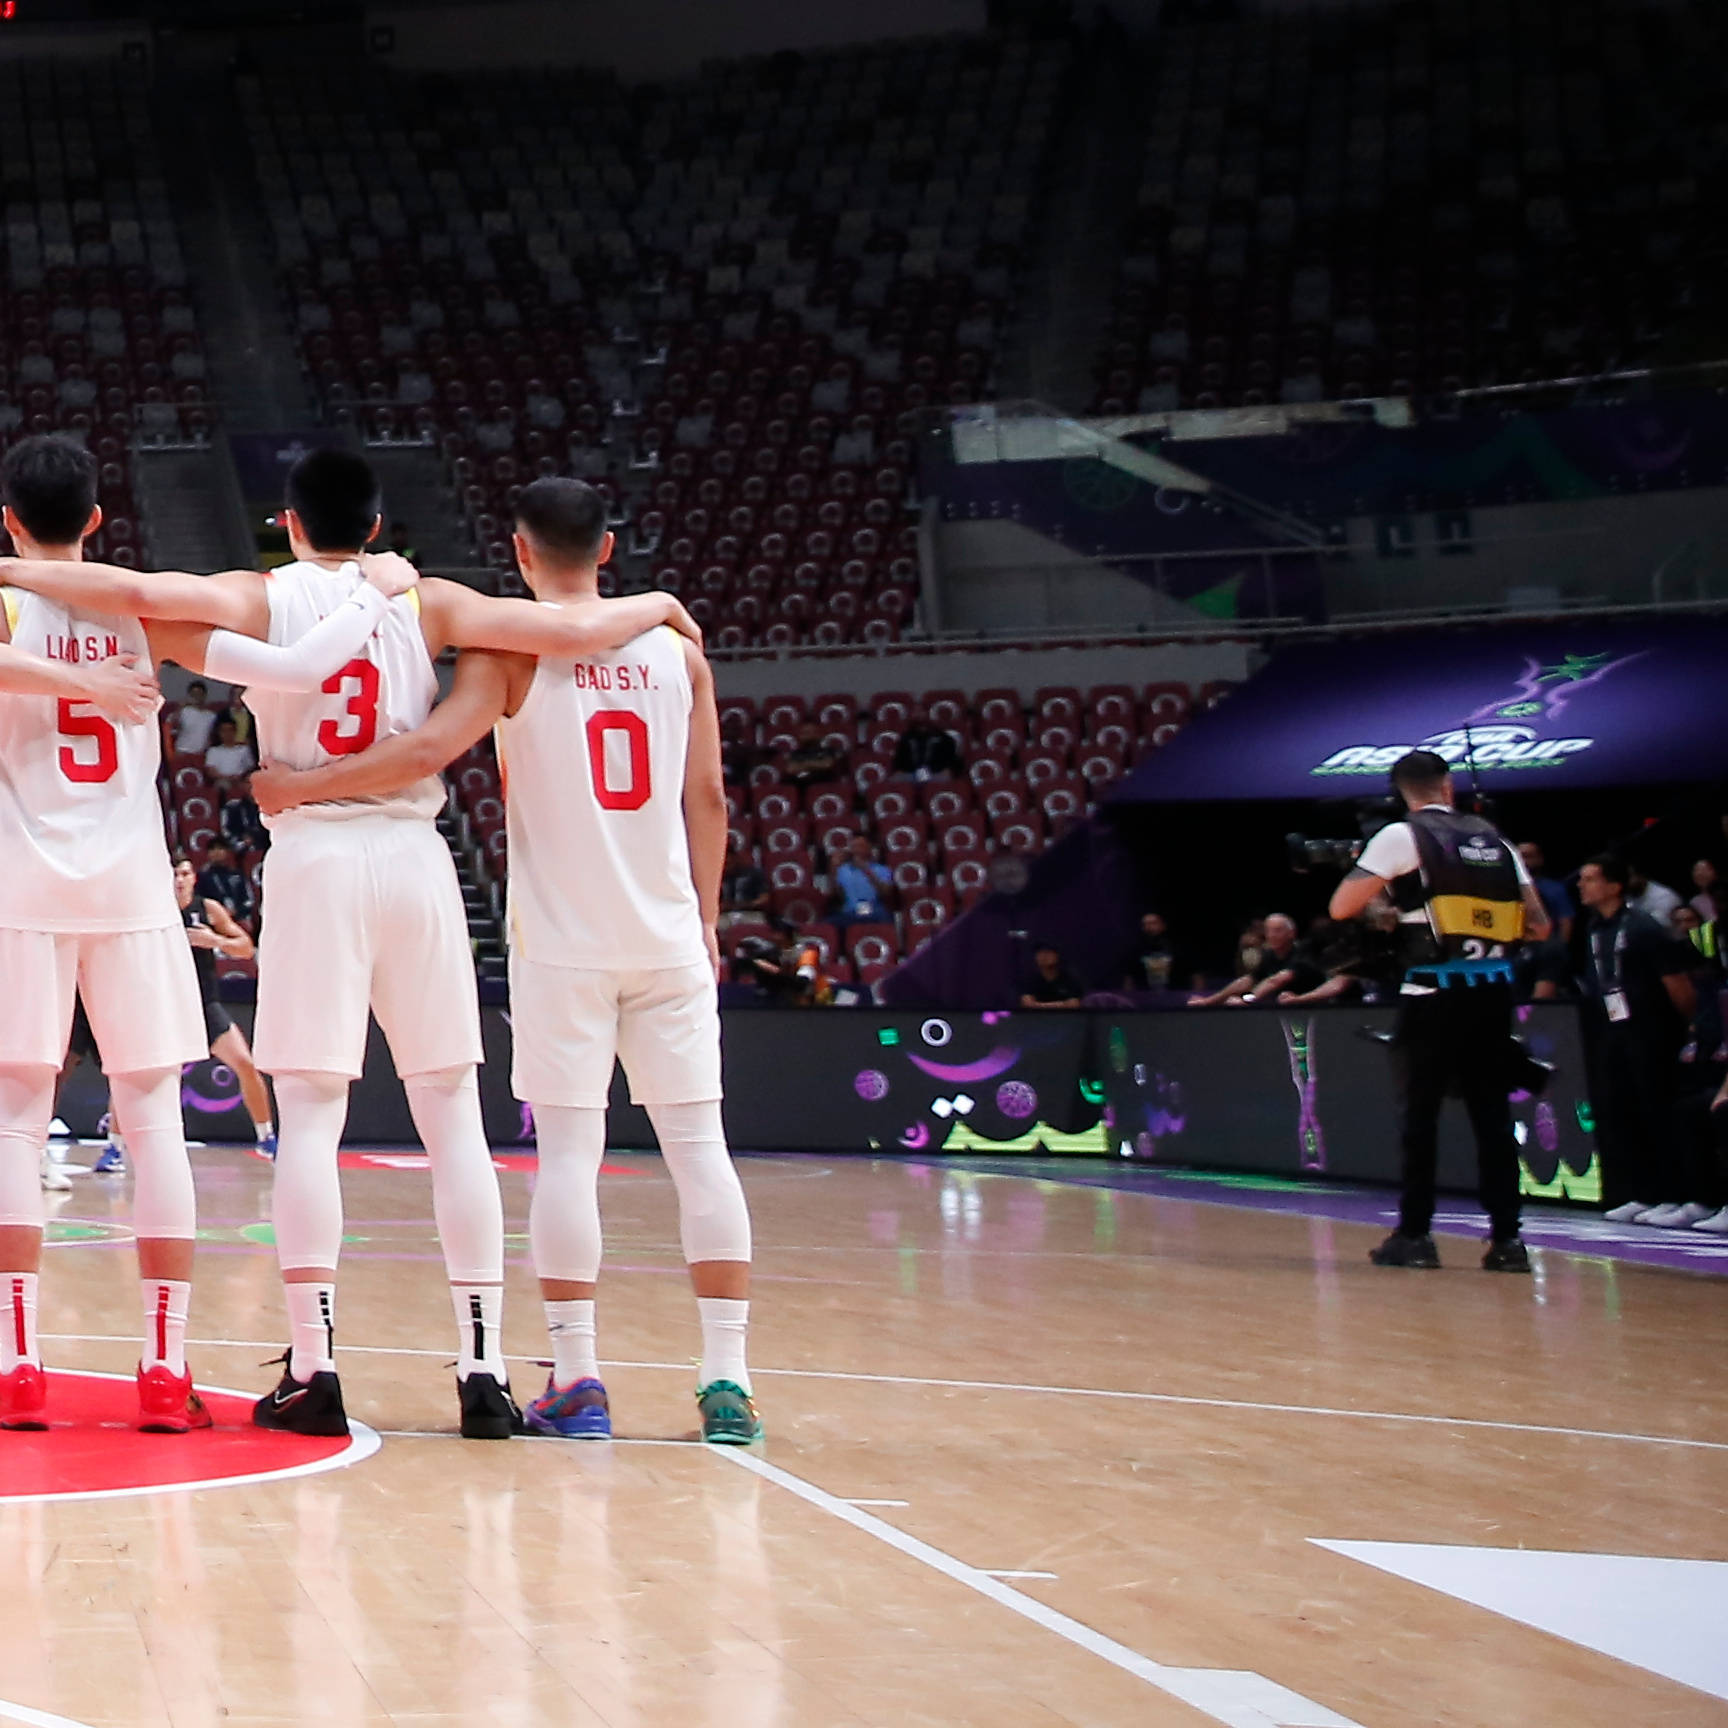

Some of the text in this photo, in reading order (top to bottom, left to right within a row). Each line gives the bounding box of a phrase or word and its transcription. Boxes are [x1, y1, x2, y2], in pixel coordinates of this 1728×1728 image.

[318, 659, 380, 755] 3
[616, 664, 659, 690] S.Y.
[57, 697, 119, 783] 5
[586, 710, 651, 810] 0
[1321, 737, 1594, 766] ASA CUP
